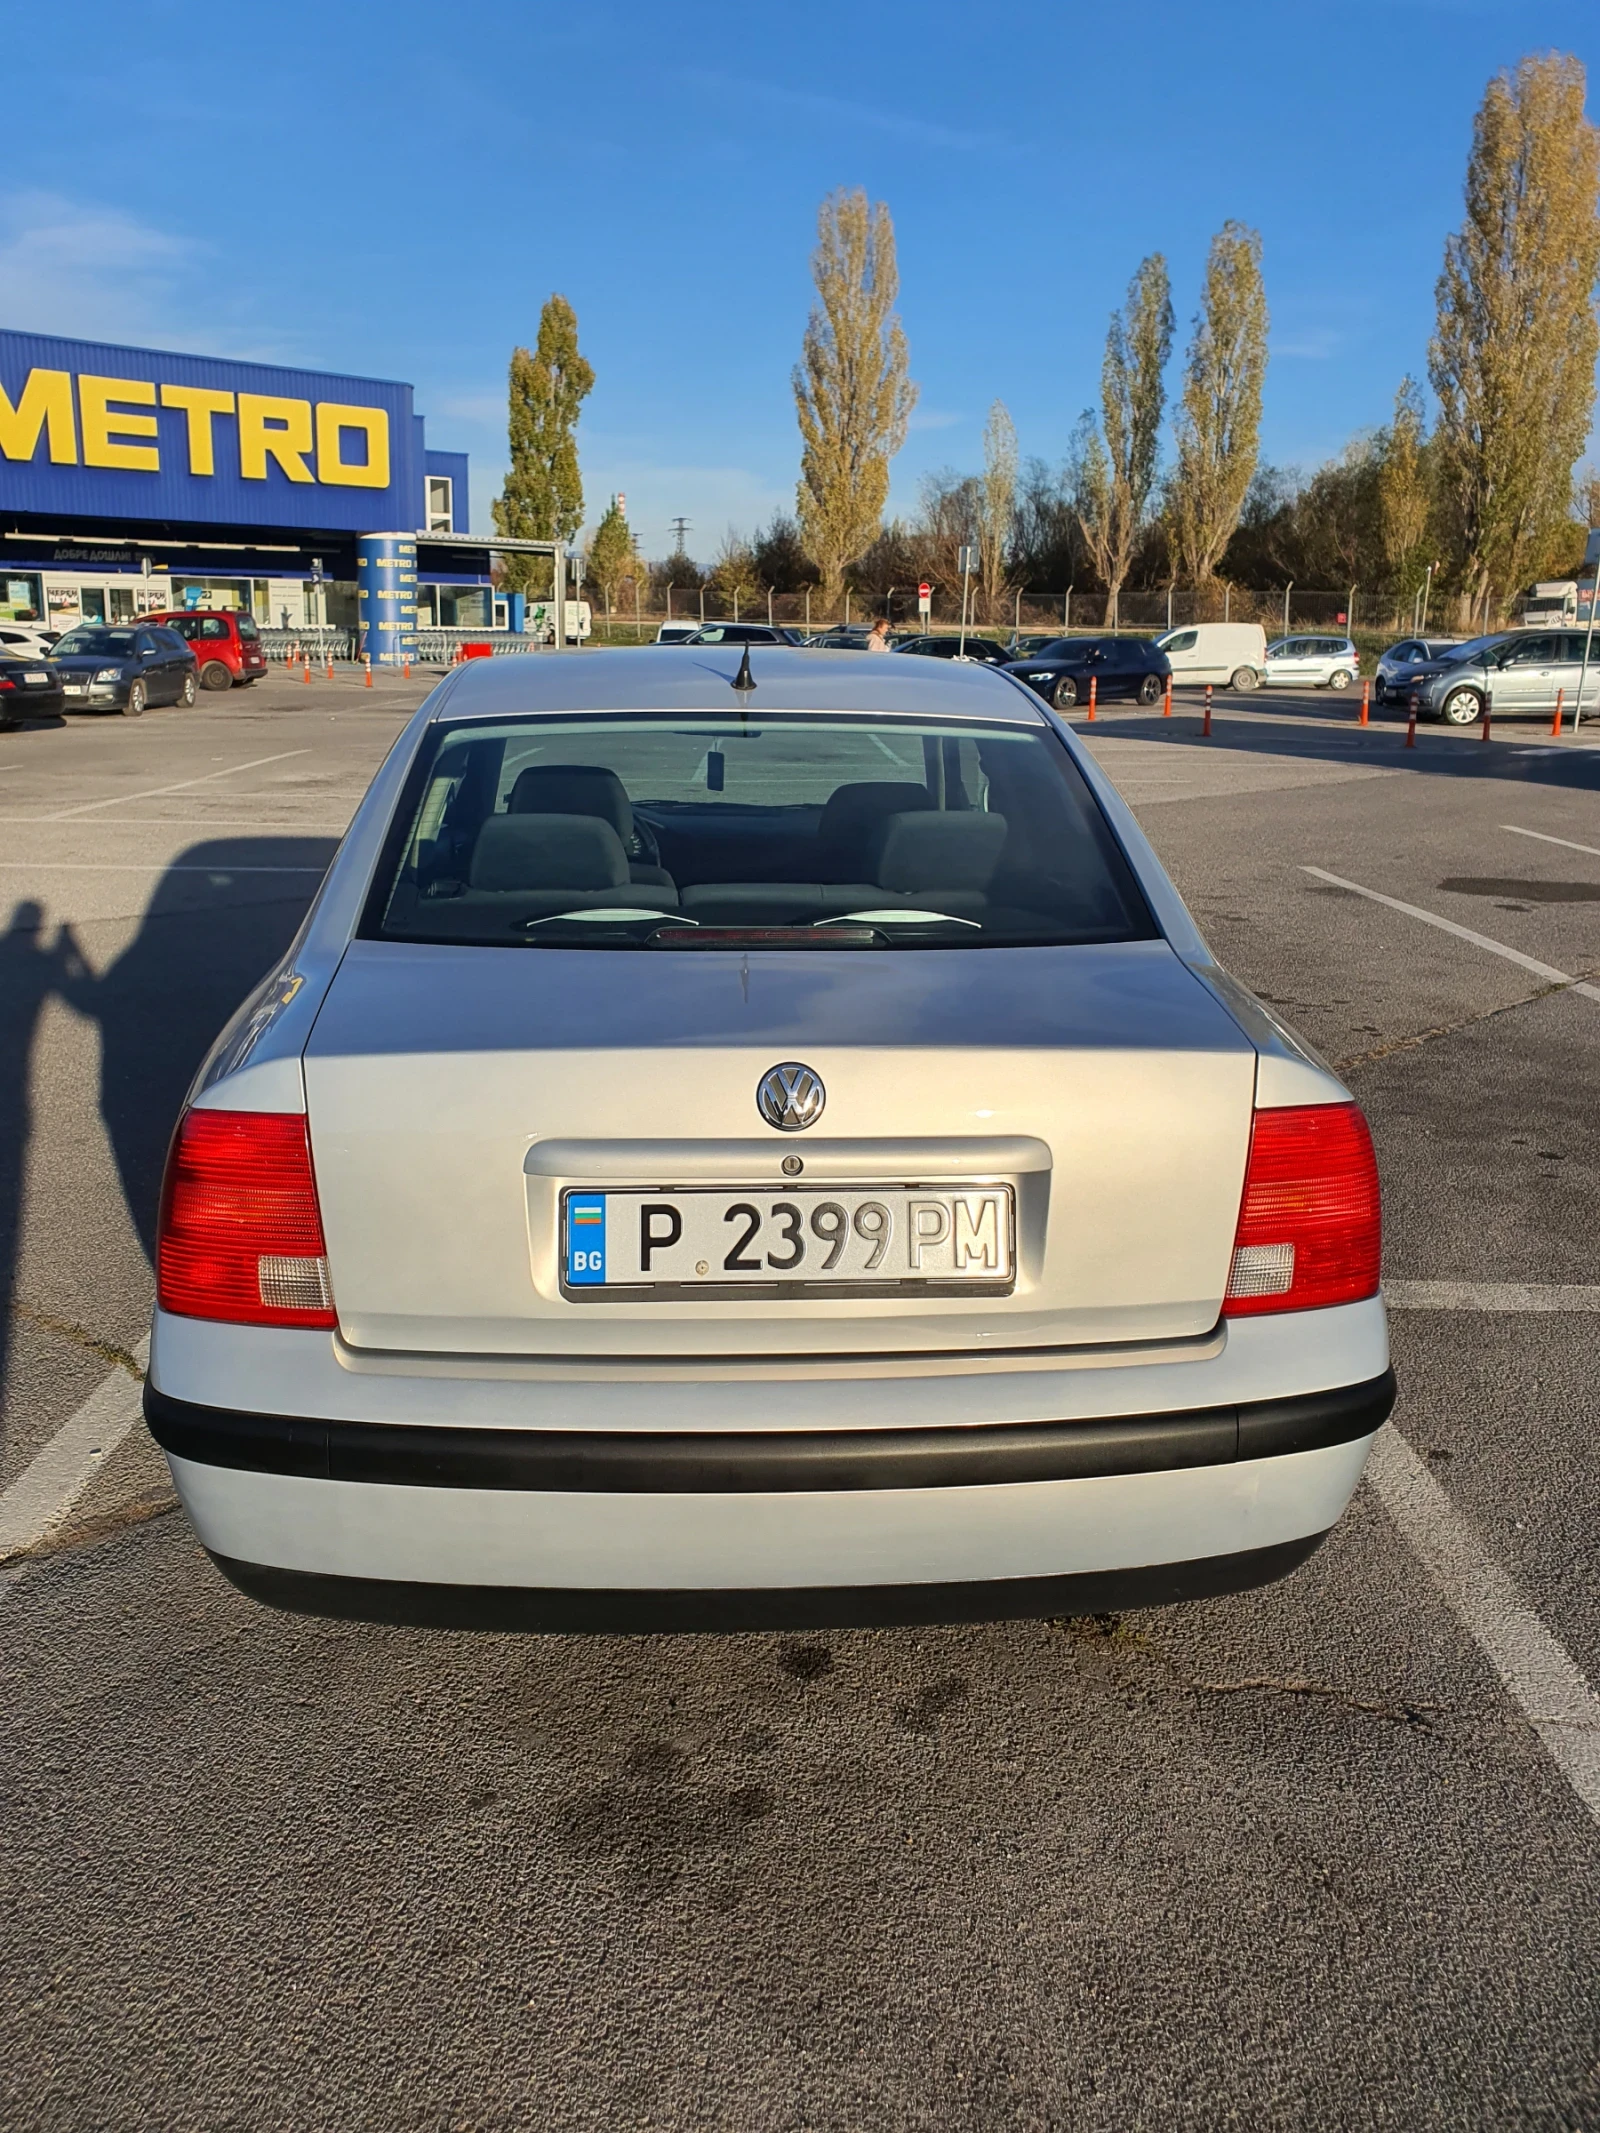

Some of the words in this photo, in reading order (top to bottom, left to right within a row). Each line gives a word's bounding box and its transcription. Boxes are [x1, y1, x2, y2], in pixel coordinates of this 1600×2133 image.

[0, 367, 390, 489] METRO
[54, 549, 88, 560] ДОБРЕ
[376, 558, 411, 568] METRO
[378, 590, 412, 599] METRO
[378, 622, 413, 631] METRO
[640, 1203, 683, 1272] P
[723, 1202, 893, 1271] 2399
[908, 1200, 999, 1269] PM
[574, 1251, 602, 1271] BG
